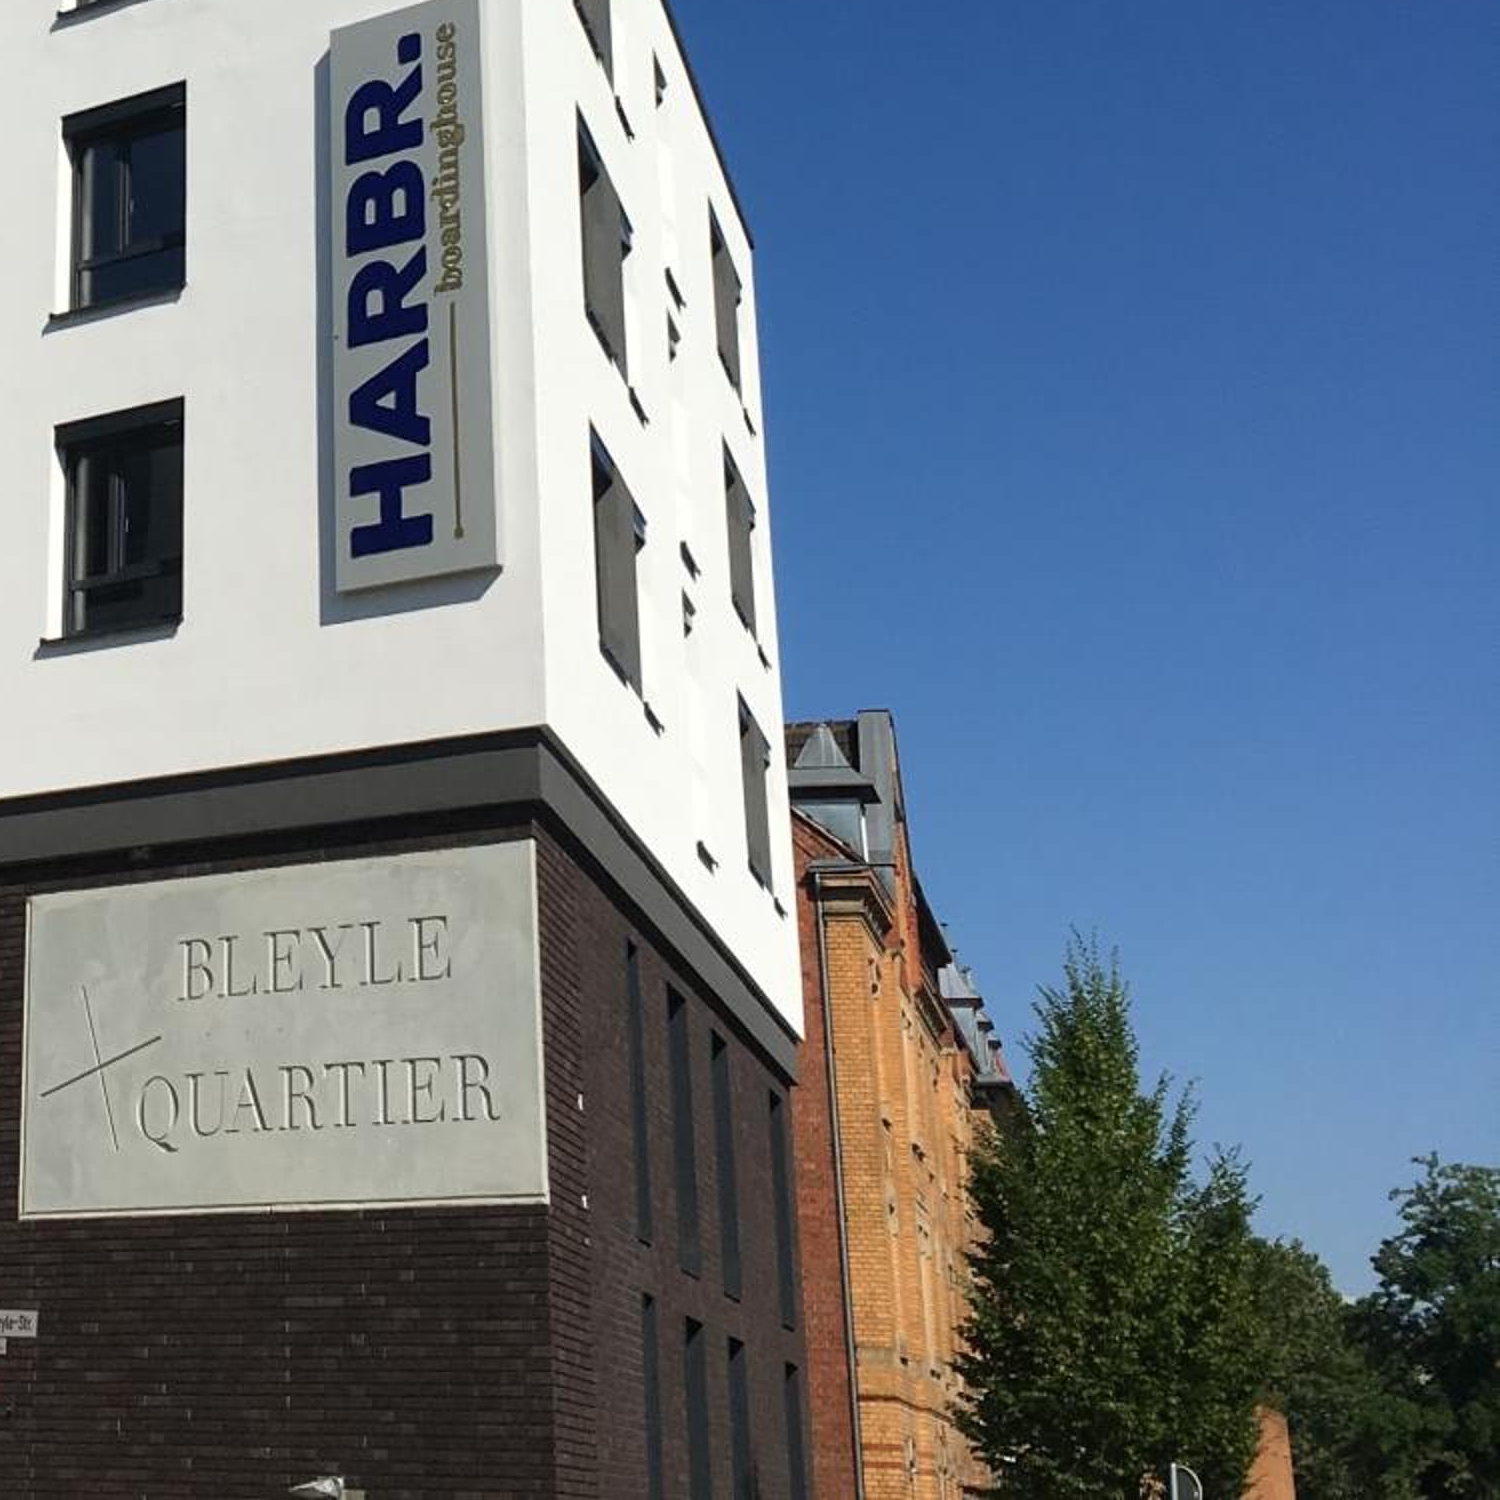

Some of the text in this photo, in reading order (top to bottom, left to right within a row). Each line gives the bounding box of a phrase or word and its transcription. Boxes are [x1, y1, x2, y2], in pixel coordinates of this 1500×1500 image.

[430, 21, 465, 298] boardinghouse
[345, 32, 433, 559] HARBR.
[177, 915, 453, 1001] BLEYLE
[136, 1053, 501, 1154] QUARTIER
